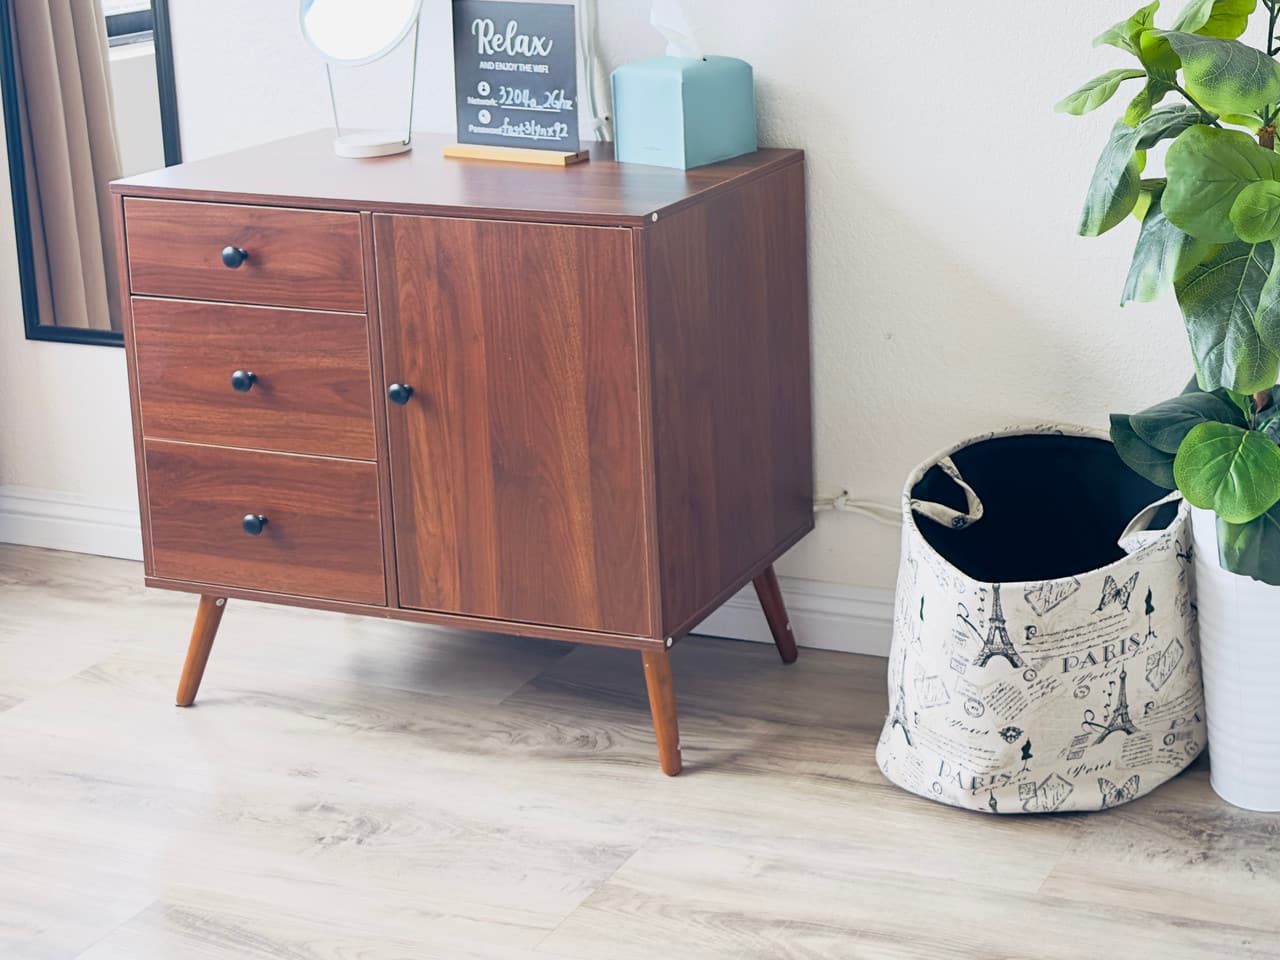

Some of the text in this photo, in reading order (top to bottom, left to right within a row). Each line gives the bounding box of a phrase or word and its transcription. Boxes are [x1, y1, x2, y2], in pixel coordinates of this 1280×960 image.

[472, 19, 552, 56] Relax
[480, 61, 495, 70] AND
[1061, 632, 1141, 673] PARIS
[938, 760, 1012, 791] PARIS
